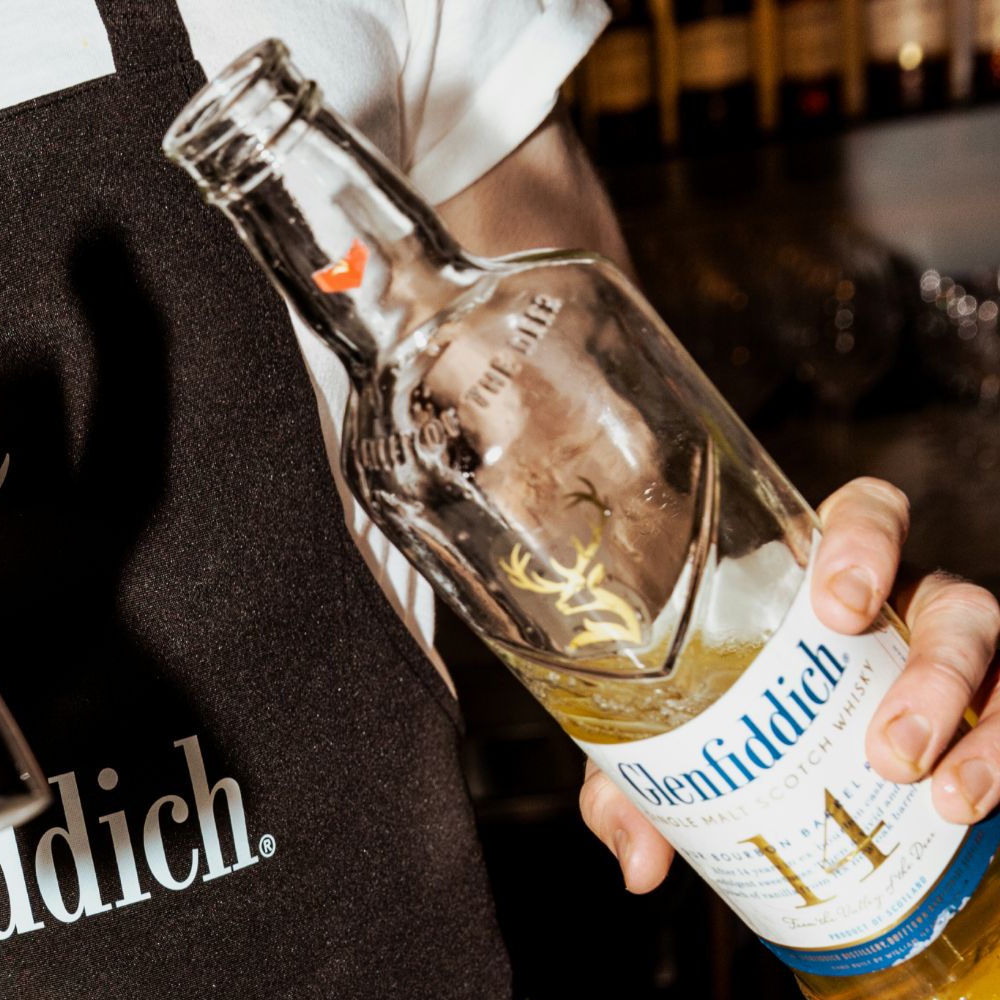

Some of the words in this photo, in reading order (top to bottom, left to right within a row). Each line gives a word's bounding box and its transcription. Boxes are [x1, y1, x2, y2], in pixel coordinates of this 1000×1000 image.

[702, 805, 751, 826] MALT
[755, 735, 833, 809] SCOTCH
[832, 658, 875, 732] WHISKY
[736, 786, 901, 910] 14
[827, 922, 868, 940] PRODUCT
[870, 915, 884, 927] OF
[885, 875, 928, 917] SCOTLAND
